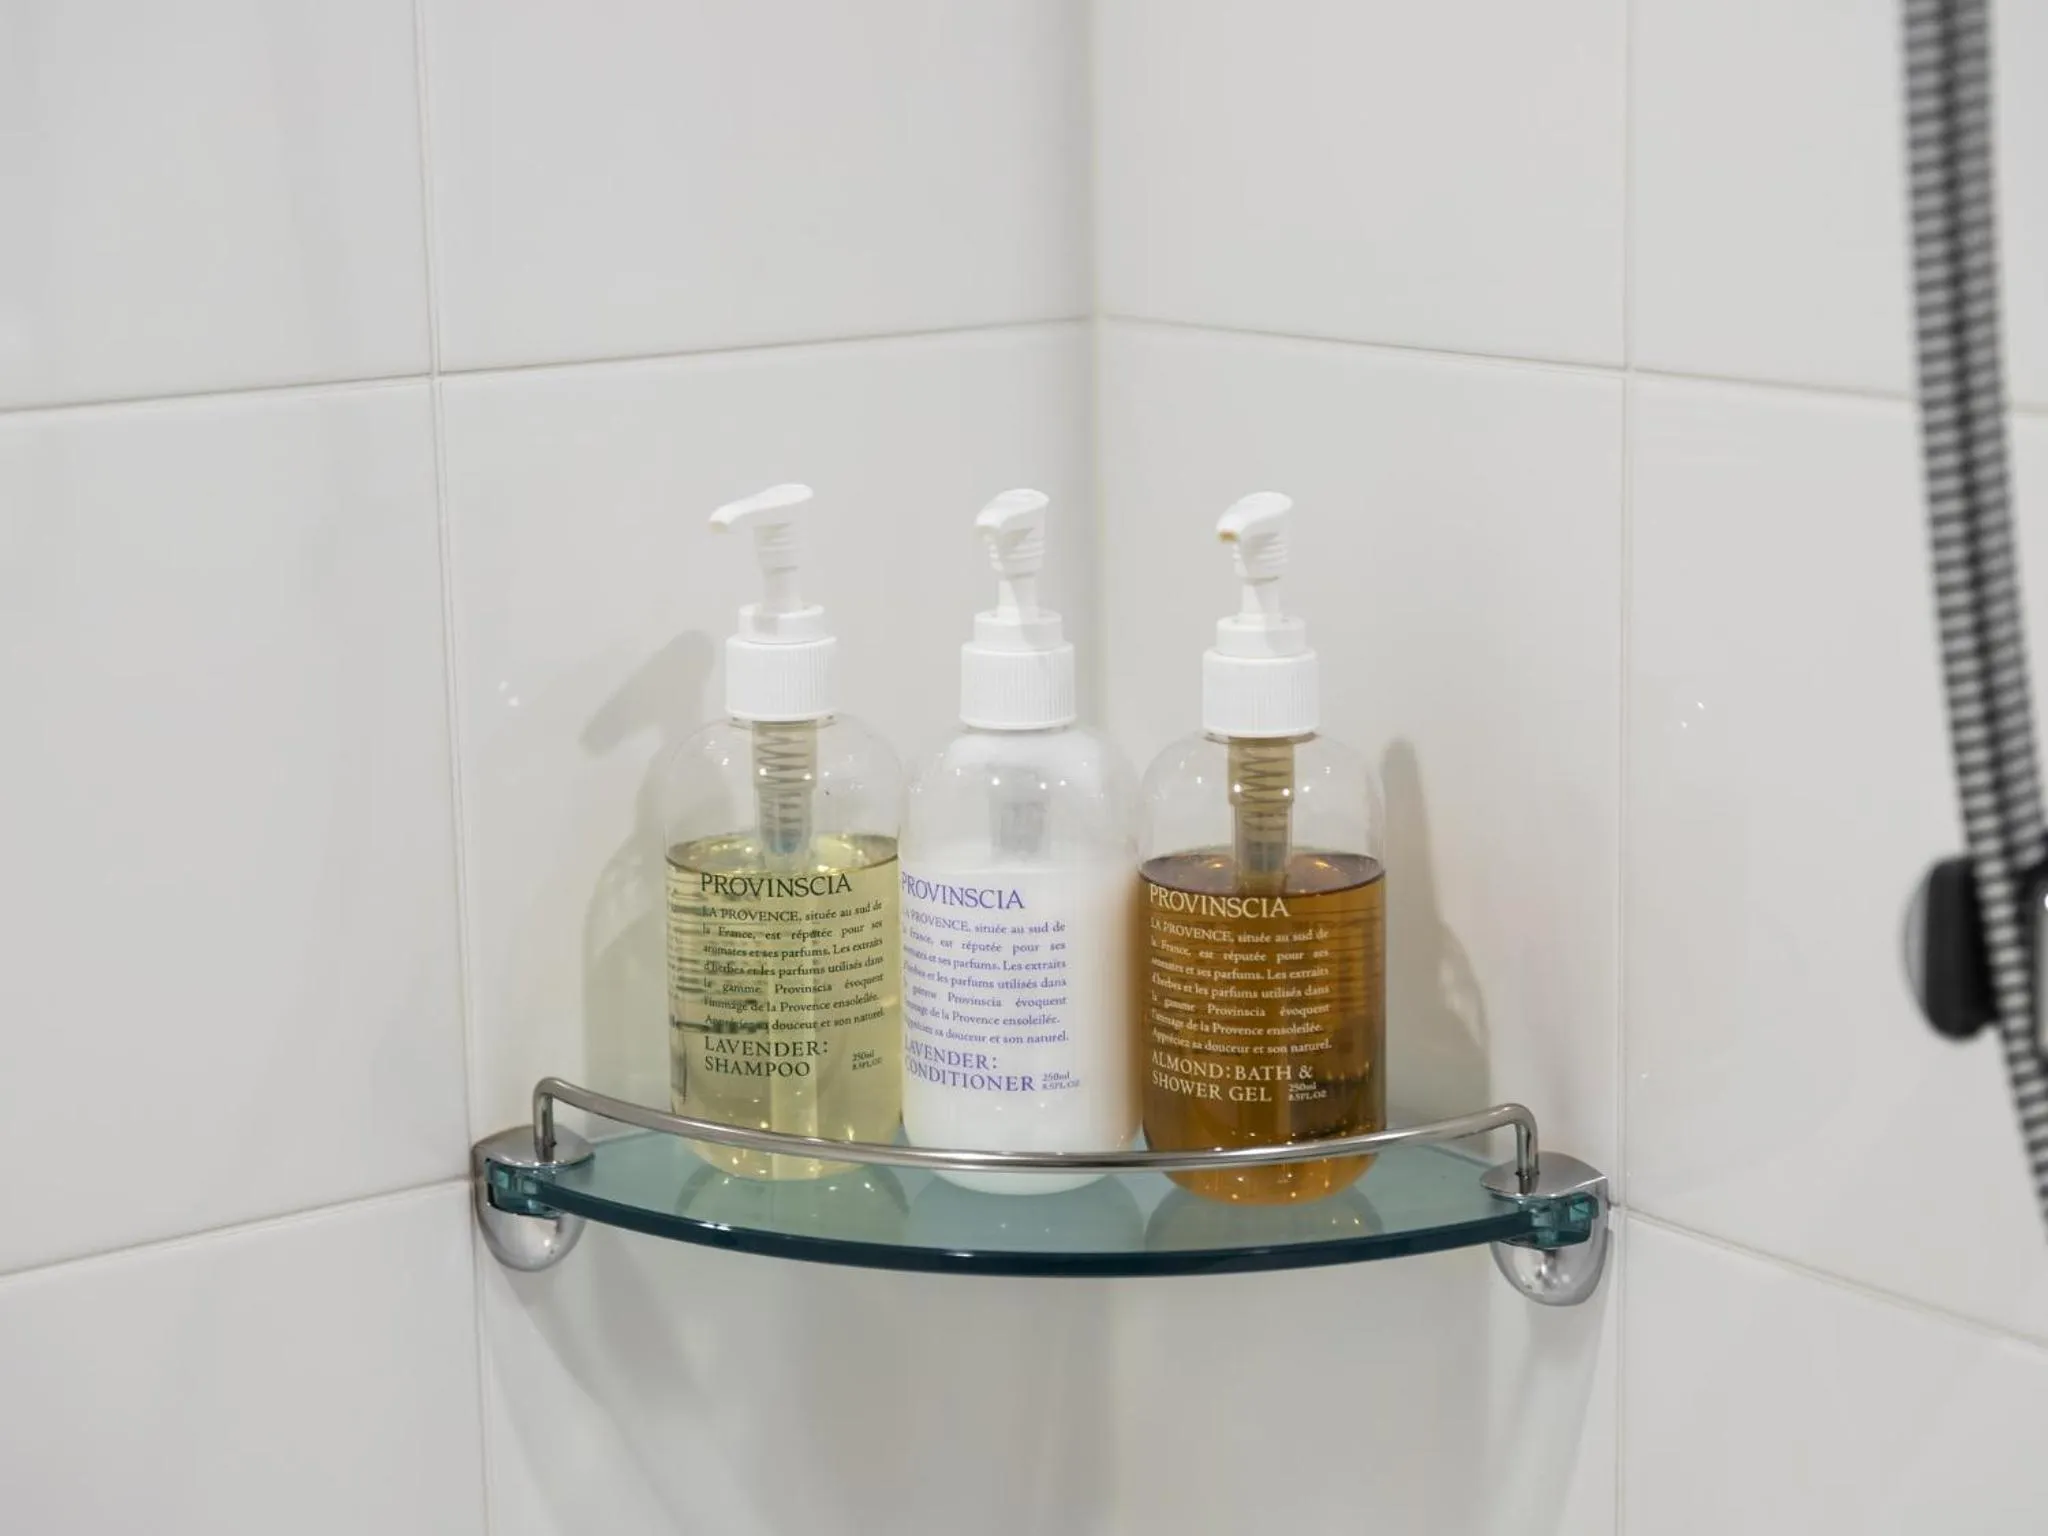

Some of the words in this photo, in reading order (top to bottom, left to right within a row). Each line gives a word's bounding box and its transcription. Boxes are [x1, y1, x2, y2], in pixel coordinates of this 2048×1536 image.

[701, 872, 852, 898] PROVINSCIA
[902, 871, 1025, 910] PROVINSCIA
[1150, 883, 1292, 918] PROVINSCIA
[805, 908, 837, 921] située
[840, 909, 852, 918] au
[855, 901, 871, 914] sud
[765, 930, 782, 940] est
[841, 924, 865, 939] pour
[975, 922, 1007, 934] située
[1011, 925, 1024, 934] au
[1028, 921, 1048, 933] sud
[1052, 919, 1066, 932] de
[1237, 931, 1271, 944] située
[1275, 934, 1289, 943] au
[833, 944, 851, 956] Les
[852, 936, 884, 953] extraits
[962, 939, 1002, 954] réputée
[1012, 943, 1039, 956] pour
[1049, 942, 1066, 951] ses
[1003, 960, 1022, 972] Les
[1024, 958, 1067, 971] extraits
[1223, 951, 1267, 965] réputée
[1276, 951, 1304, 965] pour
[1313, 949, 1329, 959] ses
[779, 964, 826, 979] parfums
[1267, 968, 1287, 980] Les
[1289, 965, 1329, 979] extraits
[775, 983, 833, 995] Provinscia
[951, 976, 995, 989] parfums
[998, 977, 1038, 990] utilisés
[1040, 976, 1067, 988] dans
[1195, 983, 1209, 995] les
[1211, 986, 1258, 1000] parfums
[1261, 986, 1302, 999] utilisés
[1304, 984, 1331, 997] dans
[766, 1000, 777, 1012] la
[780, 1000, 831, 1013] Provence
[948, 991, 1002, 1007] Provinscia
[1015, 996, 1067, 1010] évoquent
[952, 1009, 1000, 1025] Provence
[1207, 1003, 1266, 1017] Provinscia
[772, 1020, 818, 1031] douceur
[820, 1019, 830, 1028] et
[1186, 1018, 1198, 1031] de
[1200, 1020, 1210, 1033] la
[1212, 1021, 1265, 1036] Provence
[945, 1028, 987, 1043] douceur
[989, 1034, 1000, 1043] et
[1003, 1034, 1024, 1044] son
[1204, 1039, 1250, 1054] douceur
[1252, 1046, 1265, 1055] et
[1267, 1045, 1288, 1054] son
[705, 1055, 810, 1078] SHAMPOO
[905, 1054, 1035, 1093] CONDITIONER
[1299, 1064, 1313, 1080] &
[1152, 1070, 1223, 1101] SHOWER
[1229, 1086, 1272, 1103] GEL
